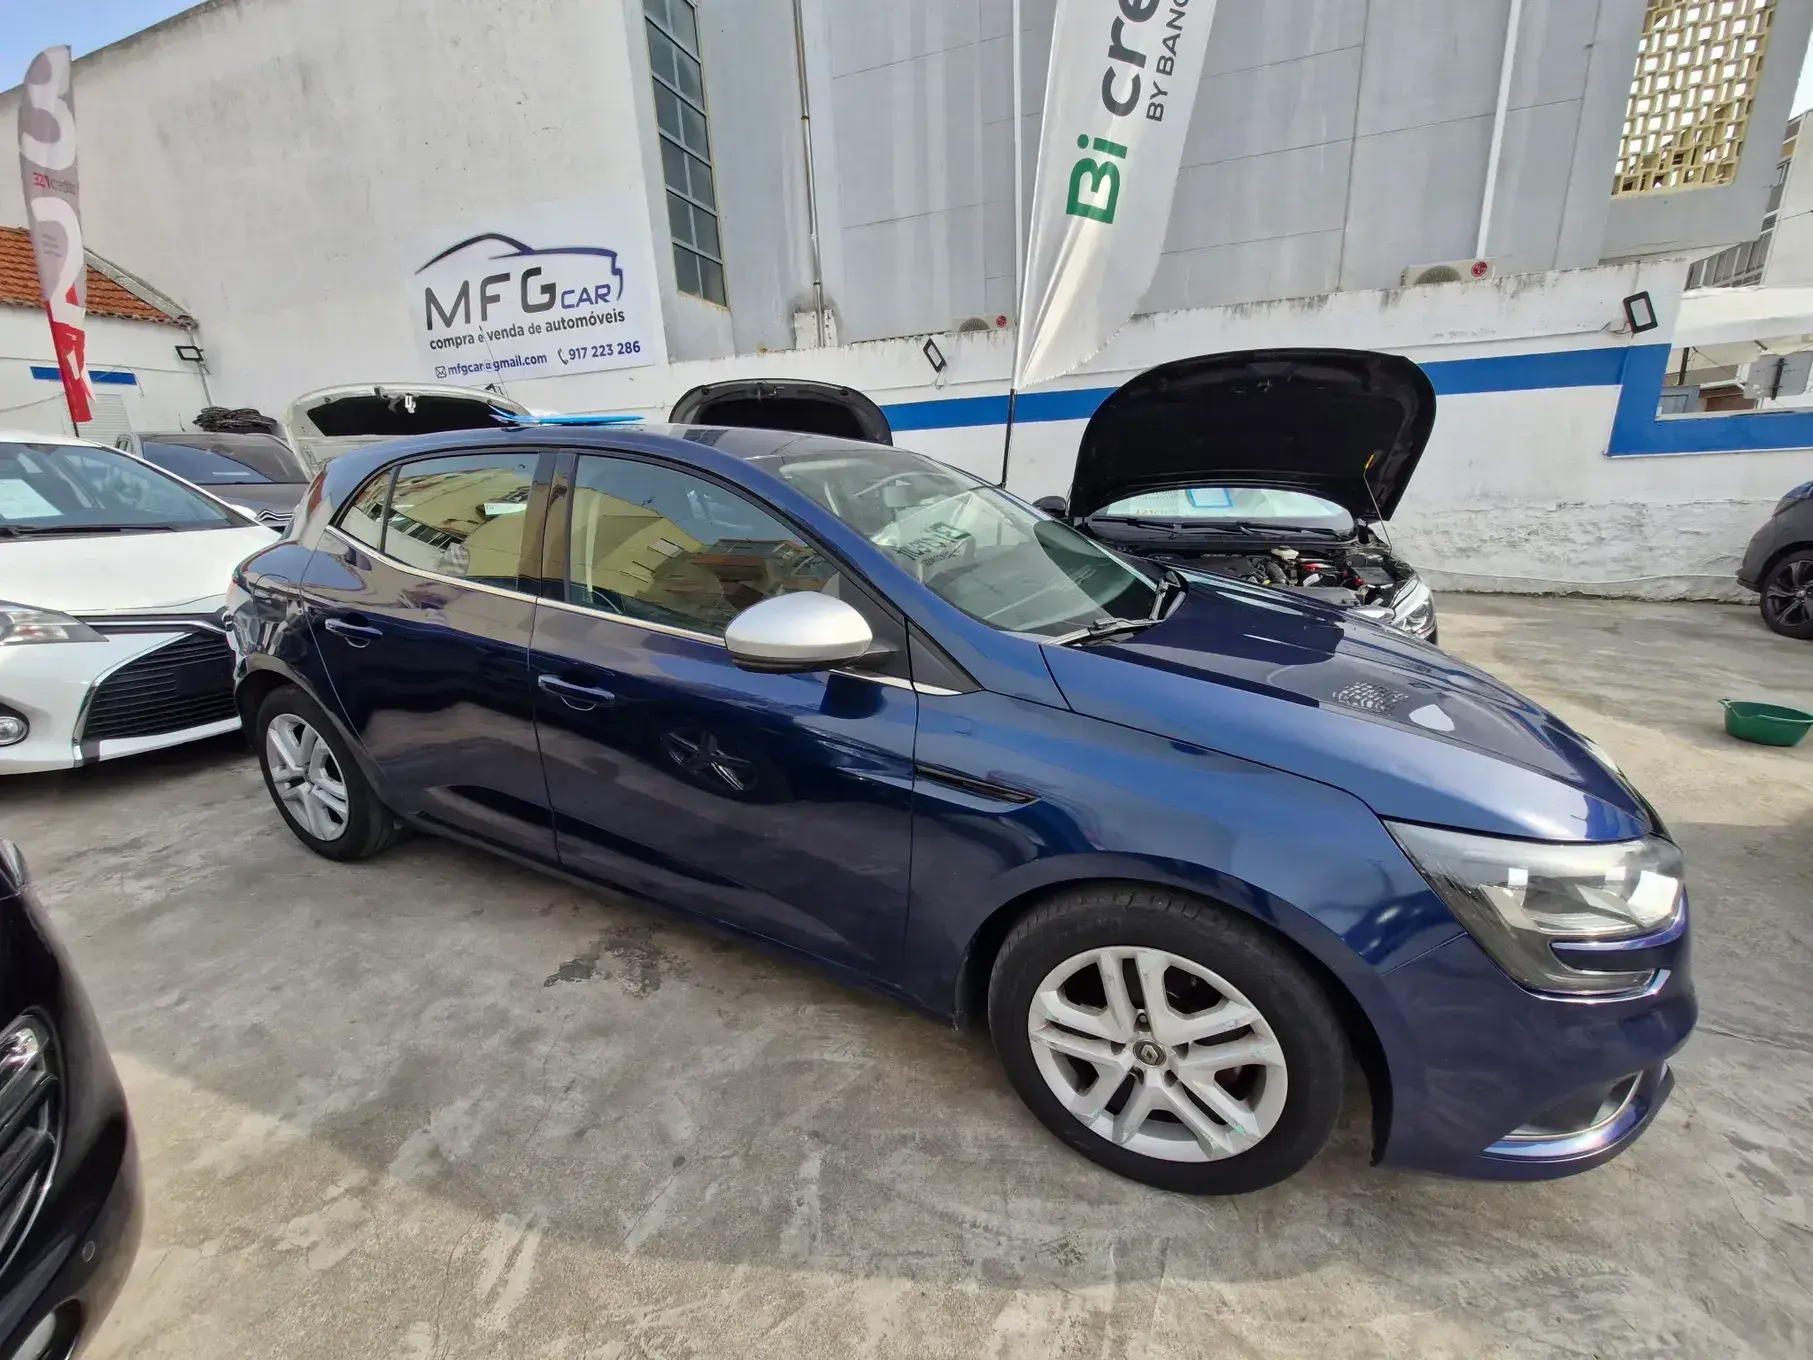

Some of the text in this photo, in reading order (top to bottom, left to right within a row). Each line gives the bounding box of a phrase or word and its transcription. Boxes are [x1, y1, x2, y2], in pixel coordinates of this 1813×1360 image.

[1146, 80, 1169, 122] BY
[1066, 133, 1128, 225] Bi
[424, 266, 611, 331] MFG CAR
[429, 308, 626, 350] compra e venda de automóveis
[568, 345, 588, 361] 917
[591, 343, 614, 358] 223
[616, 340, 641, 356] 286
